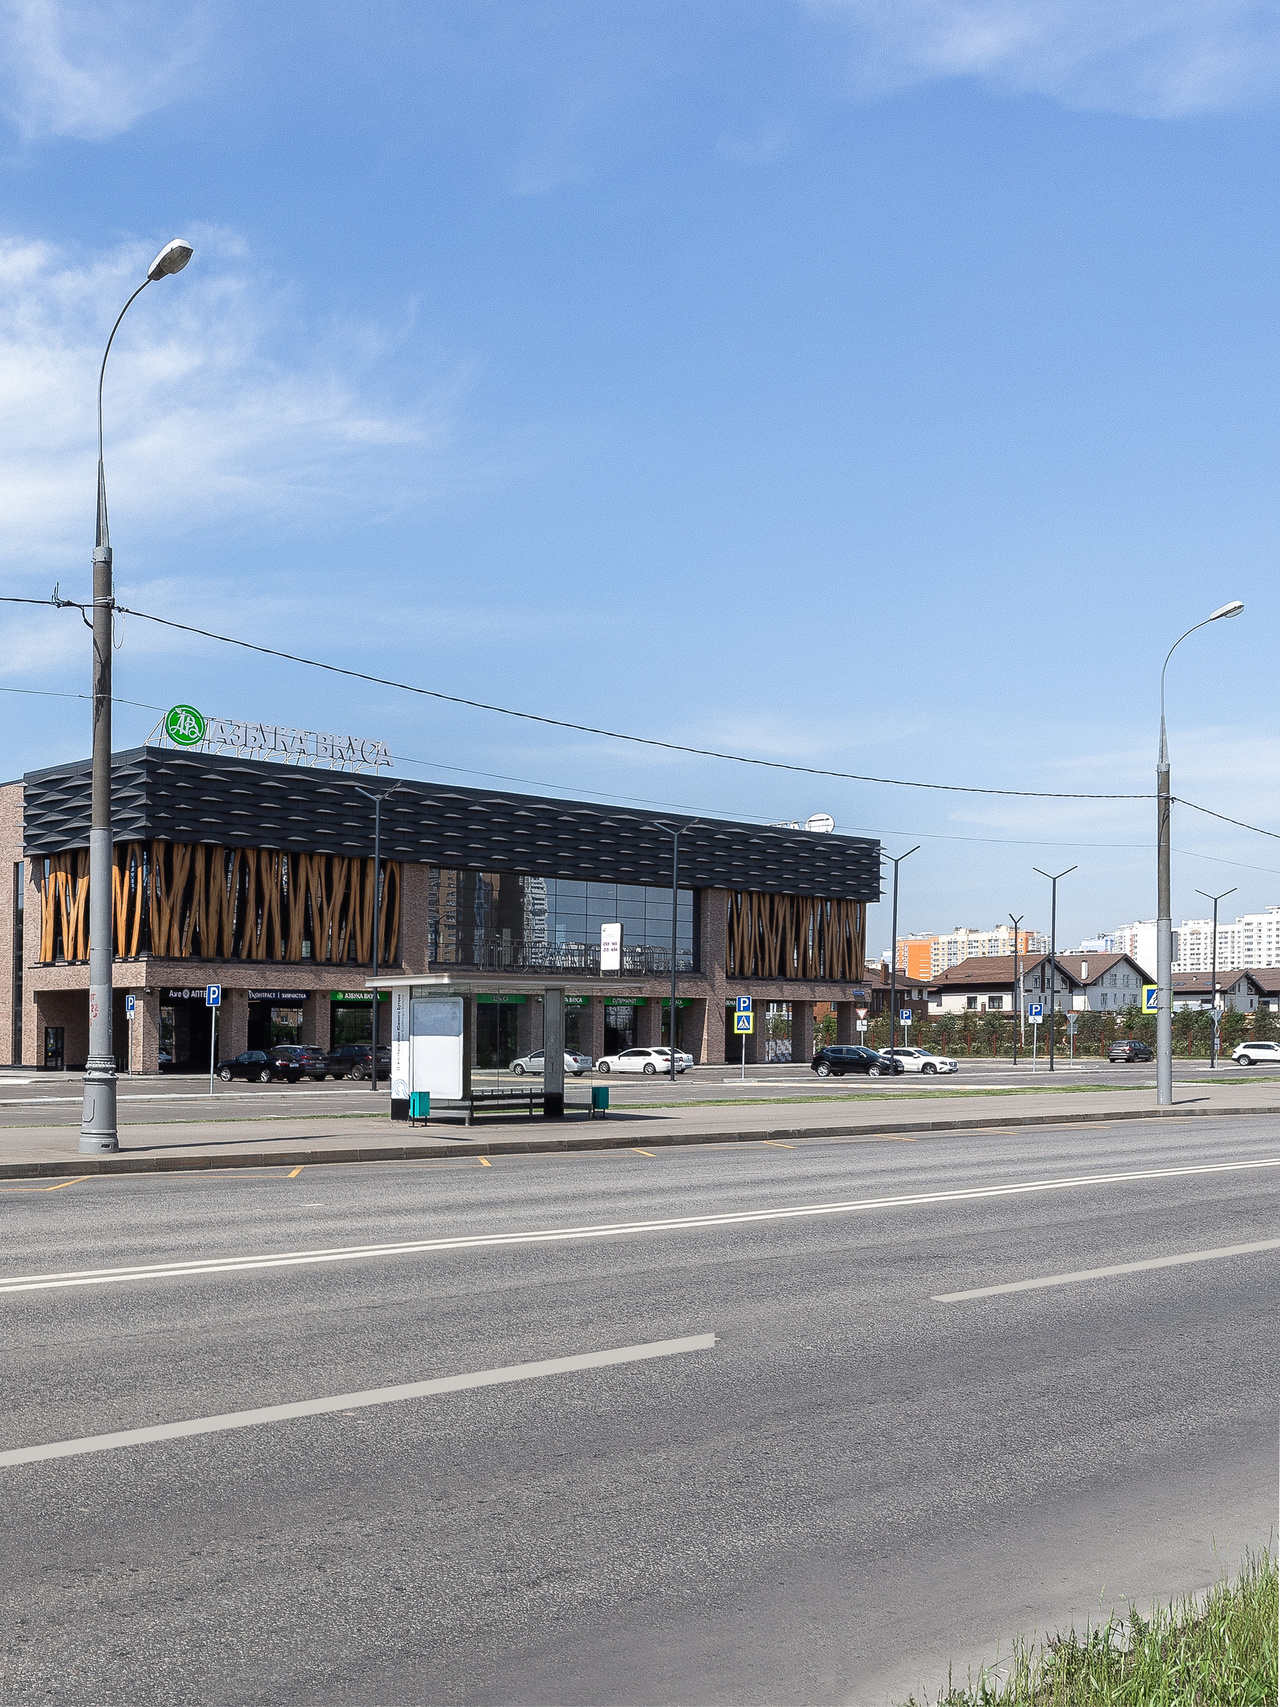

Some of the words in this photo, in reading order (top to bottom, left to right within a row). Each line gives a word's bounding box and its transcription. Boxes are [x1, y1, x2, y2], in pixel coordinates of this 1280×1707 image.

[211, 718, 314, 757] АЗБУКА
[316, 731, 393, 767] ВКУСА
[210, 987, 218, 1004] P
[128, 997, 134, 1009] P
[740, 998, 749, 1011] P
[903, 1011, 909, 1019] P
[1032, 1005, 1041, 1015] P
